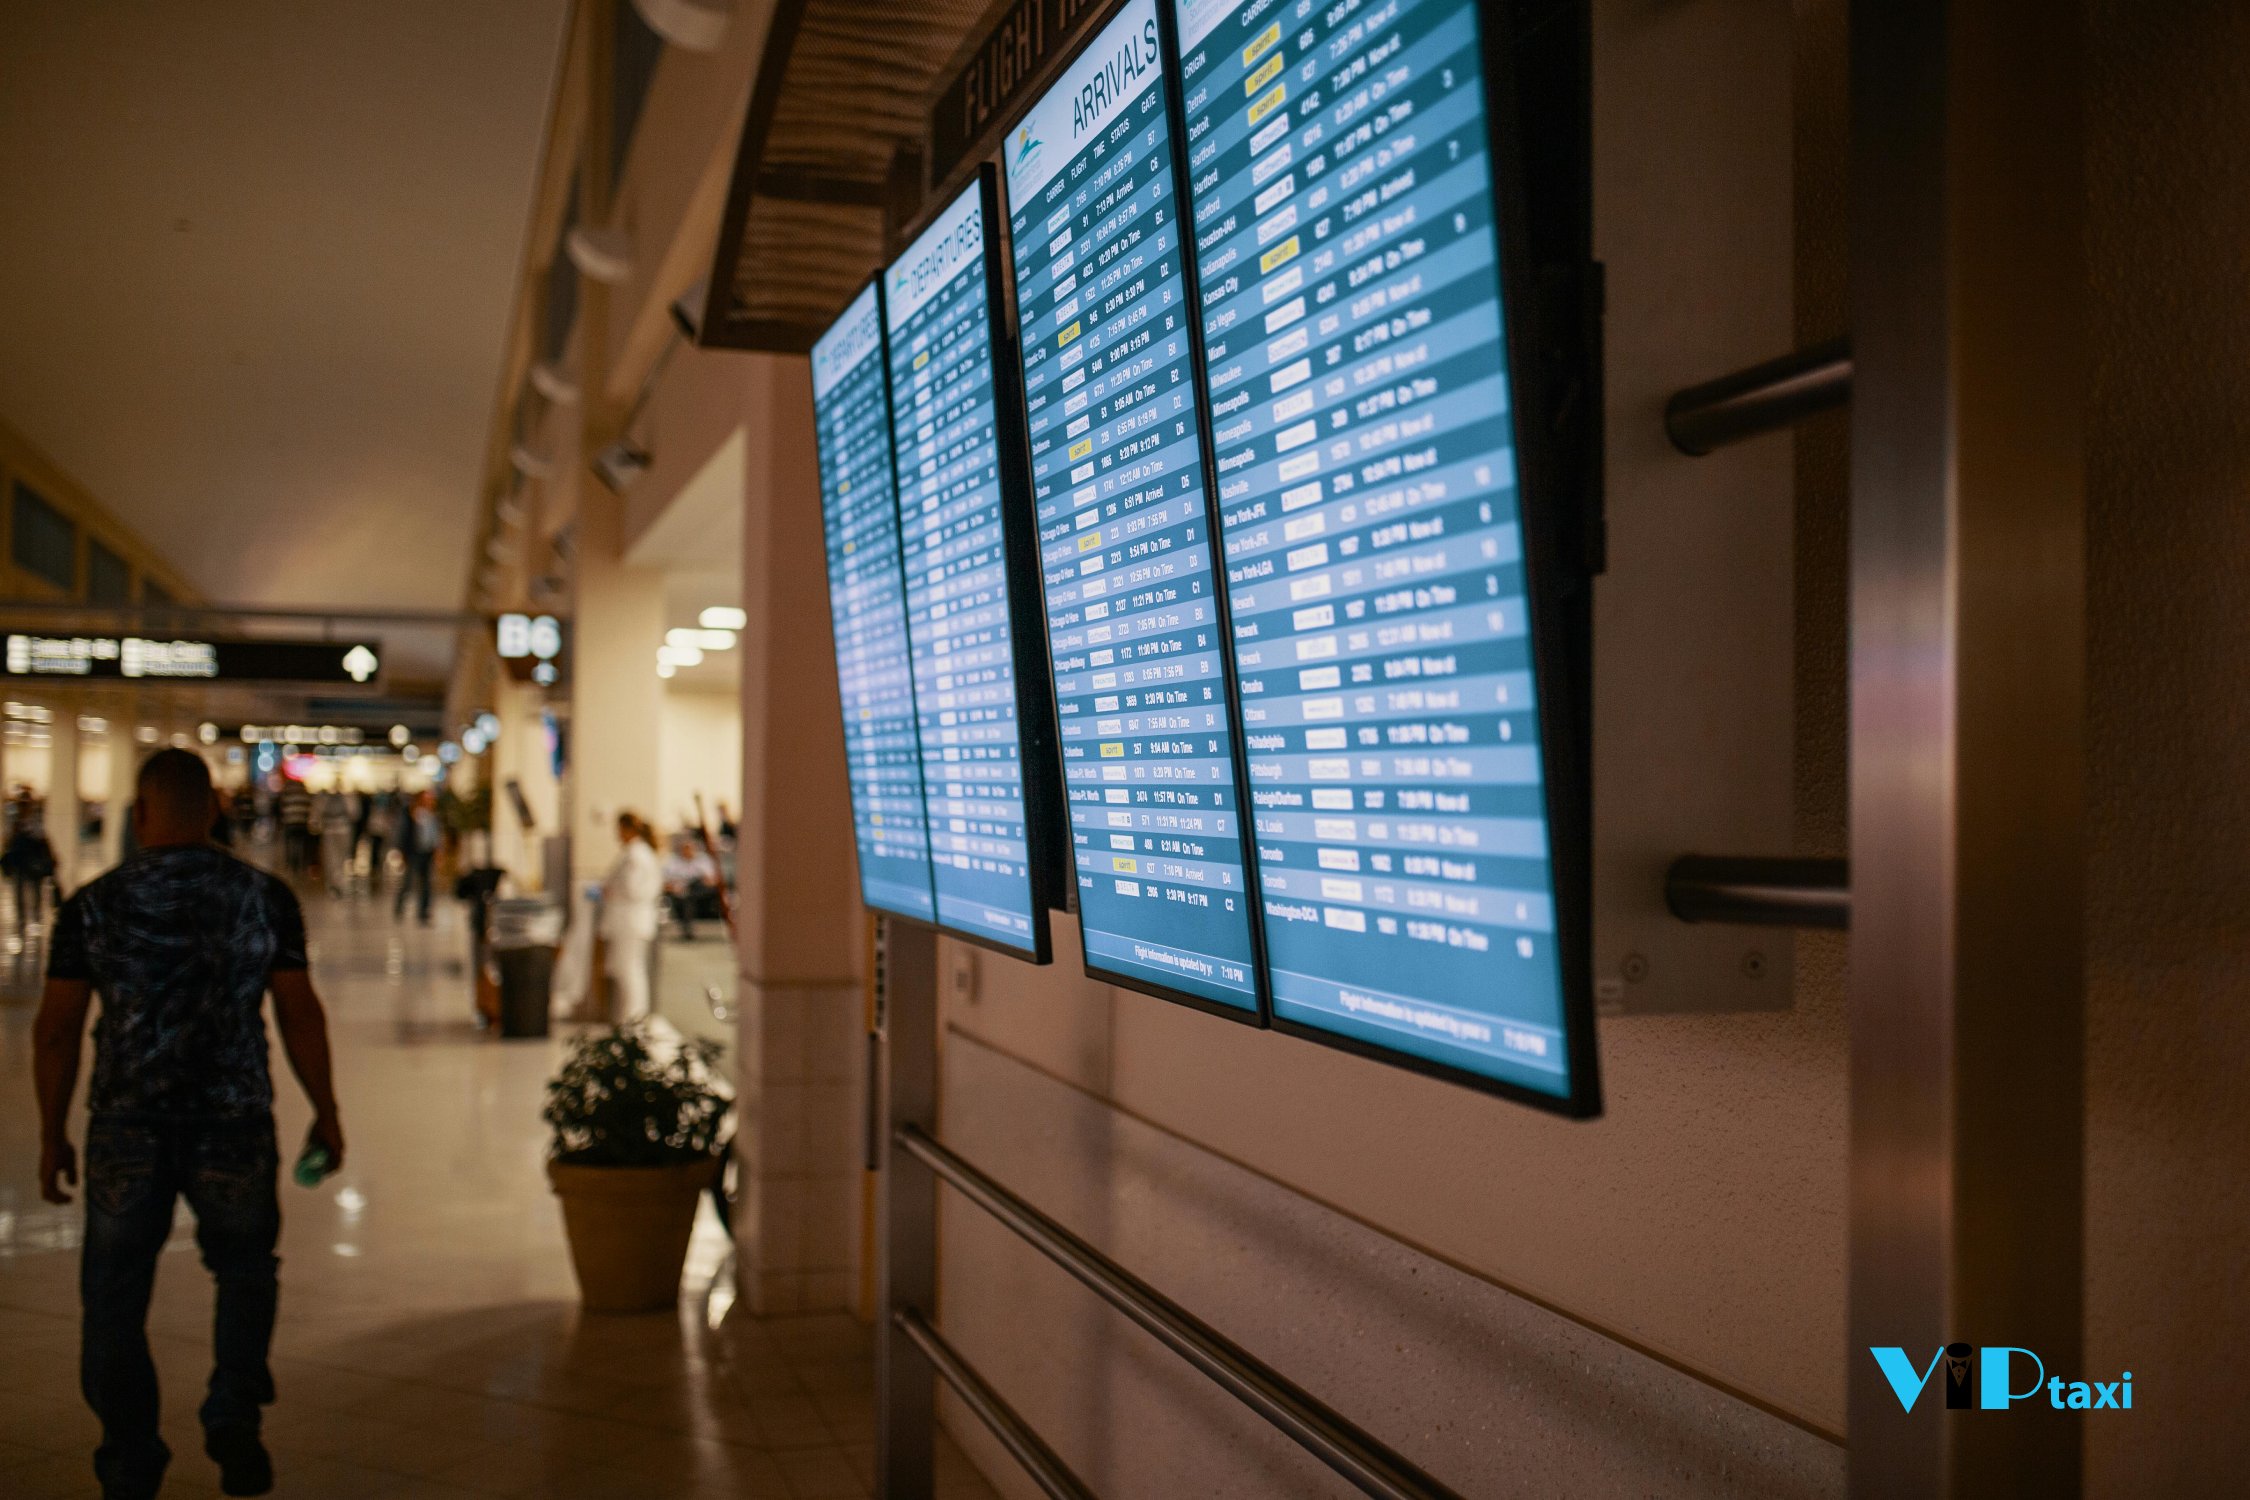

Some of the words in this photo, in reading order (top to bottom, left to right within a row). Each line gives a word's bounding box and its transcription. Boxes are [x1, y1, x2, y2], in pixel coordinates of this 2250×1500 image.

[1184, 49, 1205, 80] ORIGIN
[1187, 86, 1206, 114] Detroit
[1251, 29, 1270, 57] spirit
[1073, 18, 1158, 140] ARRIVALS
[1189, 114, 1209, 142] Detroit
[1254, 61, 1272, 88] spirit
[1191, 139, 1216, 169] Hartford
[1256, 91, 1275, 117] spirit
[1046, 177, 1064, 204] CARRIER
[1071, 156, 1087, 180] FLIGHT
[1093, 139, 1105, 160] TIME
[1110, 116, 1129, 144] STATUS
[1141, 90, 1155, 114] GATE
[1105, 192, 1114, 209] PM
[1115, 177, 1133, 201] Arrived
[1194, 167, 1218, 197] Hartford
[1196, 195, 1220, 223] Hartford
[1110, 242, 1118, 258] PM
[1120, 235, 1128, 251] On
[1128, 226, 1140, 246] Time
[1155, 208, 1163, 225] B2
[1198, 214, 1236, 252] Houston-IAH
[910, 209, 981, 300] DEPARTURES
[1112, 266, 1121, 282] PM
[1122, 260, 1130, 276] On
[1130, 252, 1142, 271] Time
[1157, 235, 1165, 252] B3
[1201, 245, 1237, 280] Indianapolis
[1115, 291, 1123, 307] PM
[1162, 287, 1171, 304] B4
[1203, 282, 1225, 307] Kansas
[1225, 274, 1238, 297] City
[1206, 319, 1217, 334] Las
[1216, 305, 1236, 331] Vegas
[1140, 329, 1149, 345] PM
[1207, 341, 1226, 362] Miami
[1124, 391, 1133, 406] AM
[1135, 387, 1143, 402] On
[1142, 380, 1155, 398] Time
[1170, 367, 1179, 383] B2
[1213, 388, 1249, 418] Minneapolis
[1150, 432, 1159, 447] PM
[1142, 463, 1150, 477] On
[1150, 458, 1163, 473] Time
[1144, 485, 1163, 502] Arrived
[1223, 512, 1237, 527] New
[1236, 501, 1266, 523] York-JFK
[1150, 539, 1158, 552] On
[1158, 535, 1171, 550] Time
[1186, 527, 1194, 541] D1
[1229, 567, 1243, 583] New
[1243, 559, 1274, 580] York-LGA
[1144, 591, 1153, 604] PM
[1155, 590, 1163, 603] On
[1163, 586, 1176, 601] Time
[1191, 580, 1200, 594] C1
[1160, 641, 1169, 653] On
[1168, 638, 1182, 652] Time
[1197, 633, 1206, 647] B4
[1166, 691, 1174, 703] On
[1174, 690, 1187, 702] Time
[1205, 713, 1214, 726] B4
[1171, 742, 1180, 753] On
[1179, 741, 1192, 753] Time
[1208, 740, 1217, 752] D4
[1247, 734, 1285, 751] Philadelphia
[1174, 767, 1182, 778] On
[1182, 767, 1195, 778] Time
[1211, 767, 1219, 778] D1
[1153, 791, 1166, 802] 11:57
[1166, 791, 1175, 802] PM
[1177, 792, 1185, 804] On
[1185, 792, 1198, 804] Time
[1214, 793, 1222, 805] D1
[1156, 816, 1168, 826] 11:31
[1168, 816, 1177, 827] PM
[1179, 817, 1193, 829] 11:24
[1192, 818, 1202, 830] PM
[1182, 842, 1190, 854] On
[1190, 843, 1204, 855] Time
[1259, 846, 1284, 861] Toronto
[1184, 867, 1203, 881] Arrived
[1176, 890, 1185, 902] PM
[1187, 892, 1199, 905] 9:17
[1198, 894, 1208, 906] PM
[1225, 898, 1233, 911] C2
[1265, 901, 1319, 925] Washington-DCA
[1134, 944, 1148, 961] Flight
[1147, 947, 1174, 965] information
[1178, 954, 1199, 974] updated
[1199, 959, 1206, 976] by
[1233, 967, 1243, 982] PM
